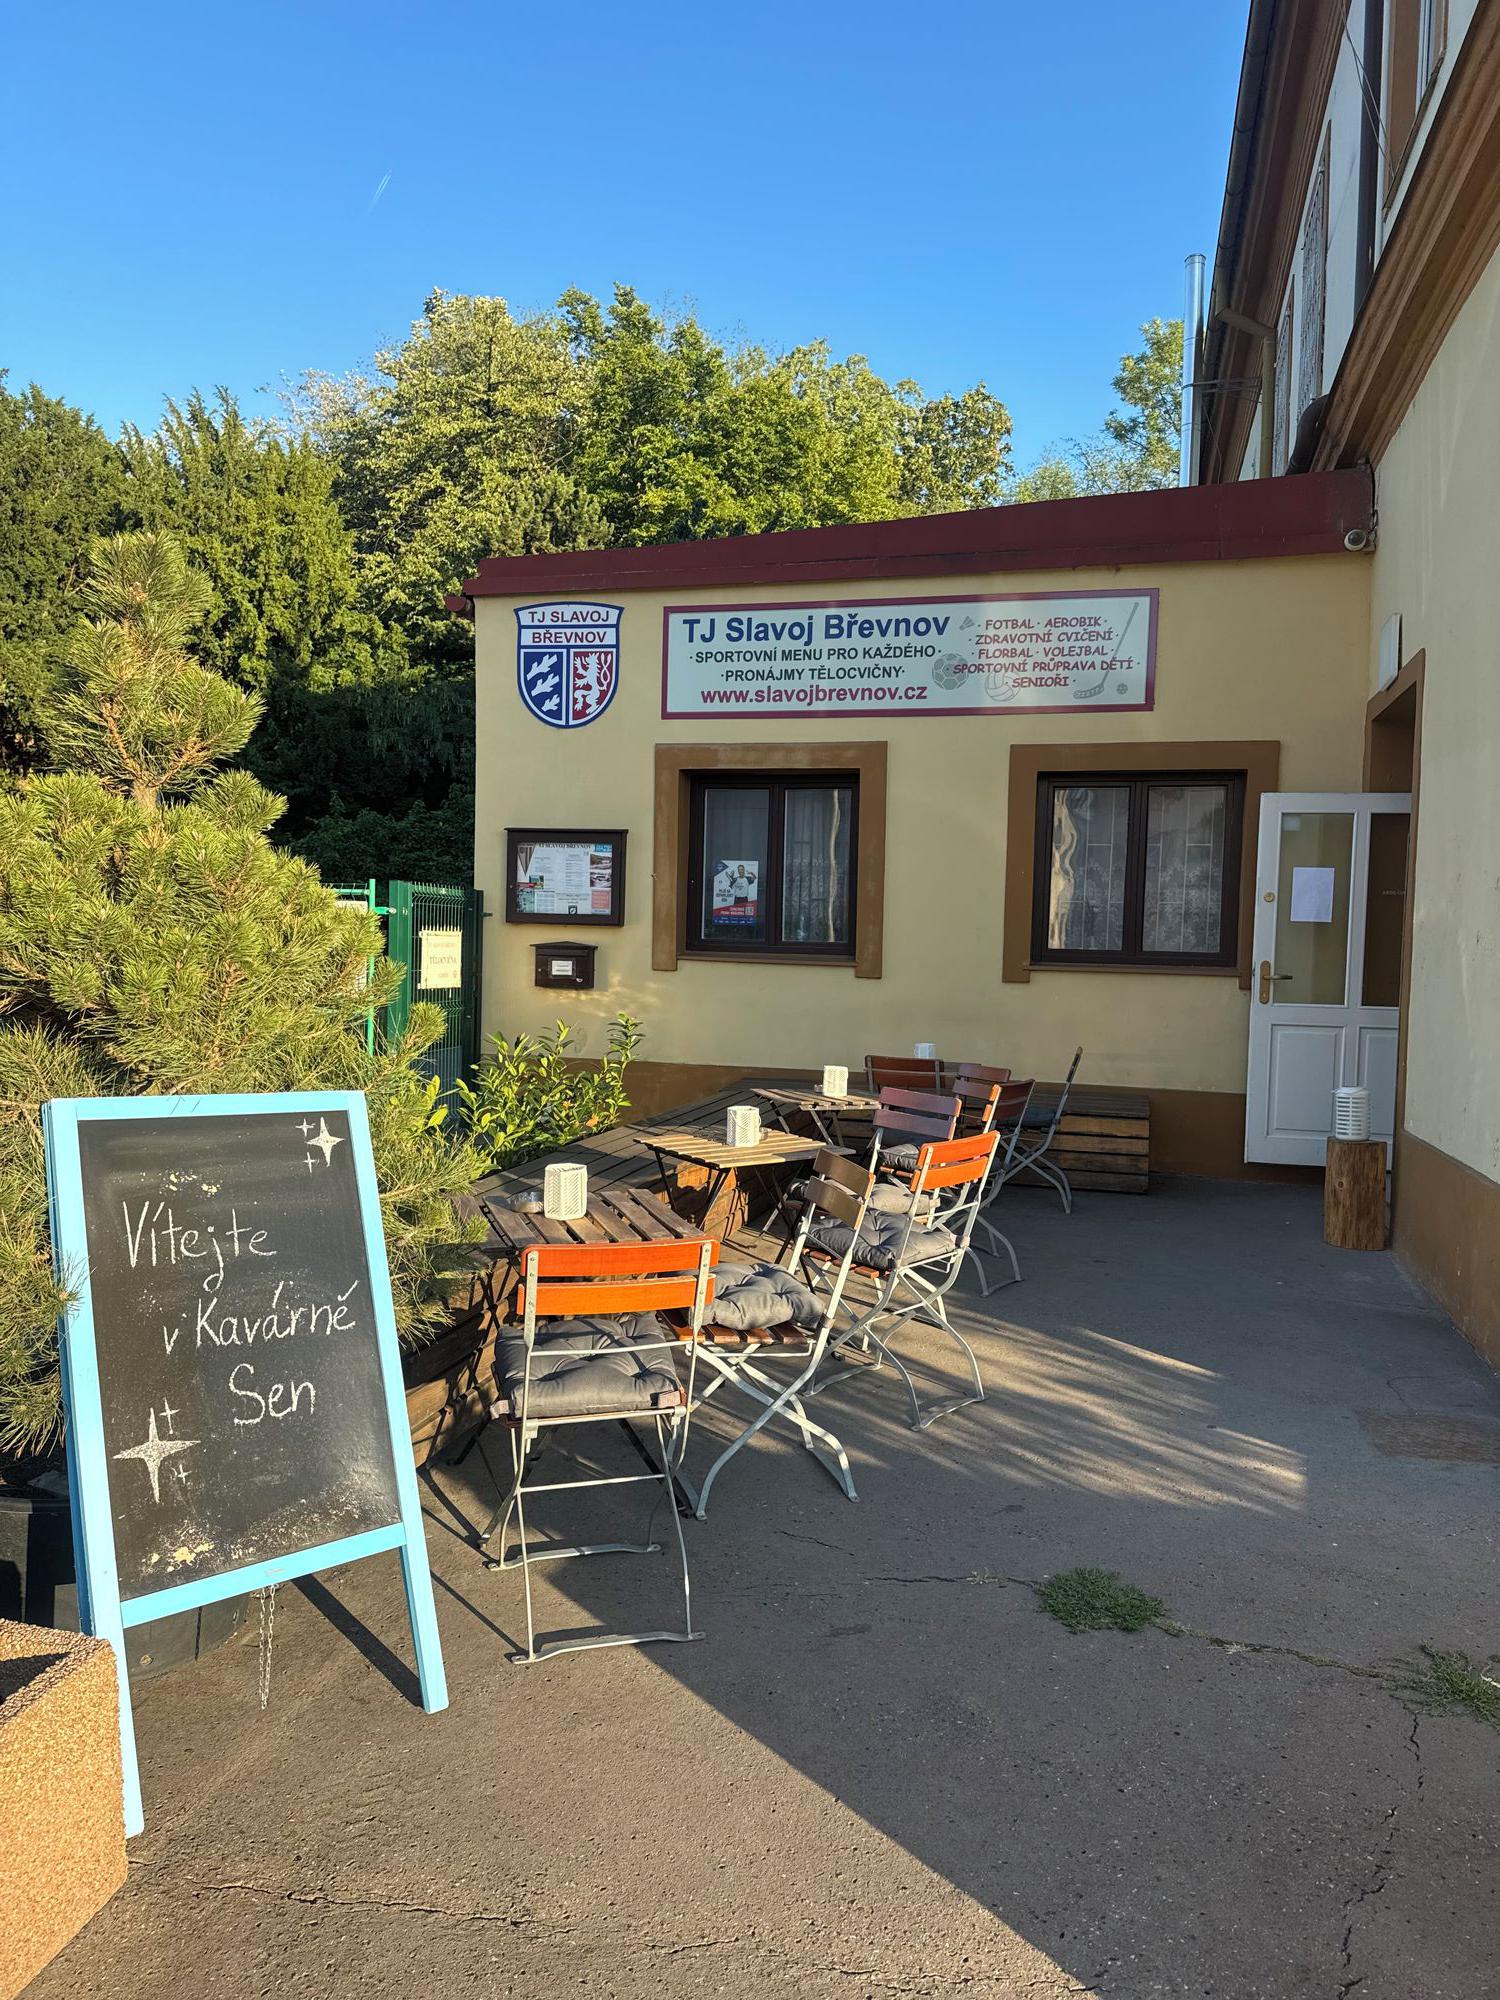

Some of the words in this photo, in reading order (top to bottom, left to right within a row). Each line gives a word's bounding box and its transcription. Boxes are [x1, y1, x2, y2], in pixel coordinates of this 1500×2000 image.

[528, 611, 545, 623] TJ
[550, 610, 609, 623] SLAVOJ
[985, 618, 1034, 630] FOTBAL
[1044, 616, 1102, 628] AEROBIK
[532, 629, 607, 643] BŘEVNOV
[683, 618, 716, 643] TJ
[726, 615, 813, 647] Slavoj
[824, 612, 950, 640] Břevnov
[975, 629, 1053, 645] ZDRAVOTNÍ
[1057, 627, 1113, 642] CVIČENÍ
[695, 647, 778, 663] SPORTOVNÍ
[781, 648, 823, 661] MENU
[827, 647, 858, 660] PRO
[862, 643, 936, 659] KAŽDÉHO
[978, 647, 1033, 660] FLORBAL
[1043, 645, 1108, 657] VOLEJBAL
[725, 666, 805, 682] PRONÁJMY
[808, 663, 902, 680] TĚLOCVIČNY
[953, 659, 1028, 674] SPORTOVNÍ
[1032, 657, 1096, 672] PRŮPRAVA
[1100, 656, 1134, 671] DĚTÍ
[1012, 673, 1069, 688] SENIOŘI
[701, 684, 928, 707] www.slavojbrevnov.cz
[122, 1200, 277, 1293] Vítejte
[163, 1325, 179, 1354] v
[195, 1279, 360, 1348] Kavárně
[229, 1363, 316, 1426] Sen
